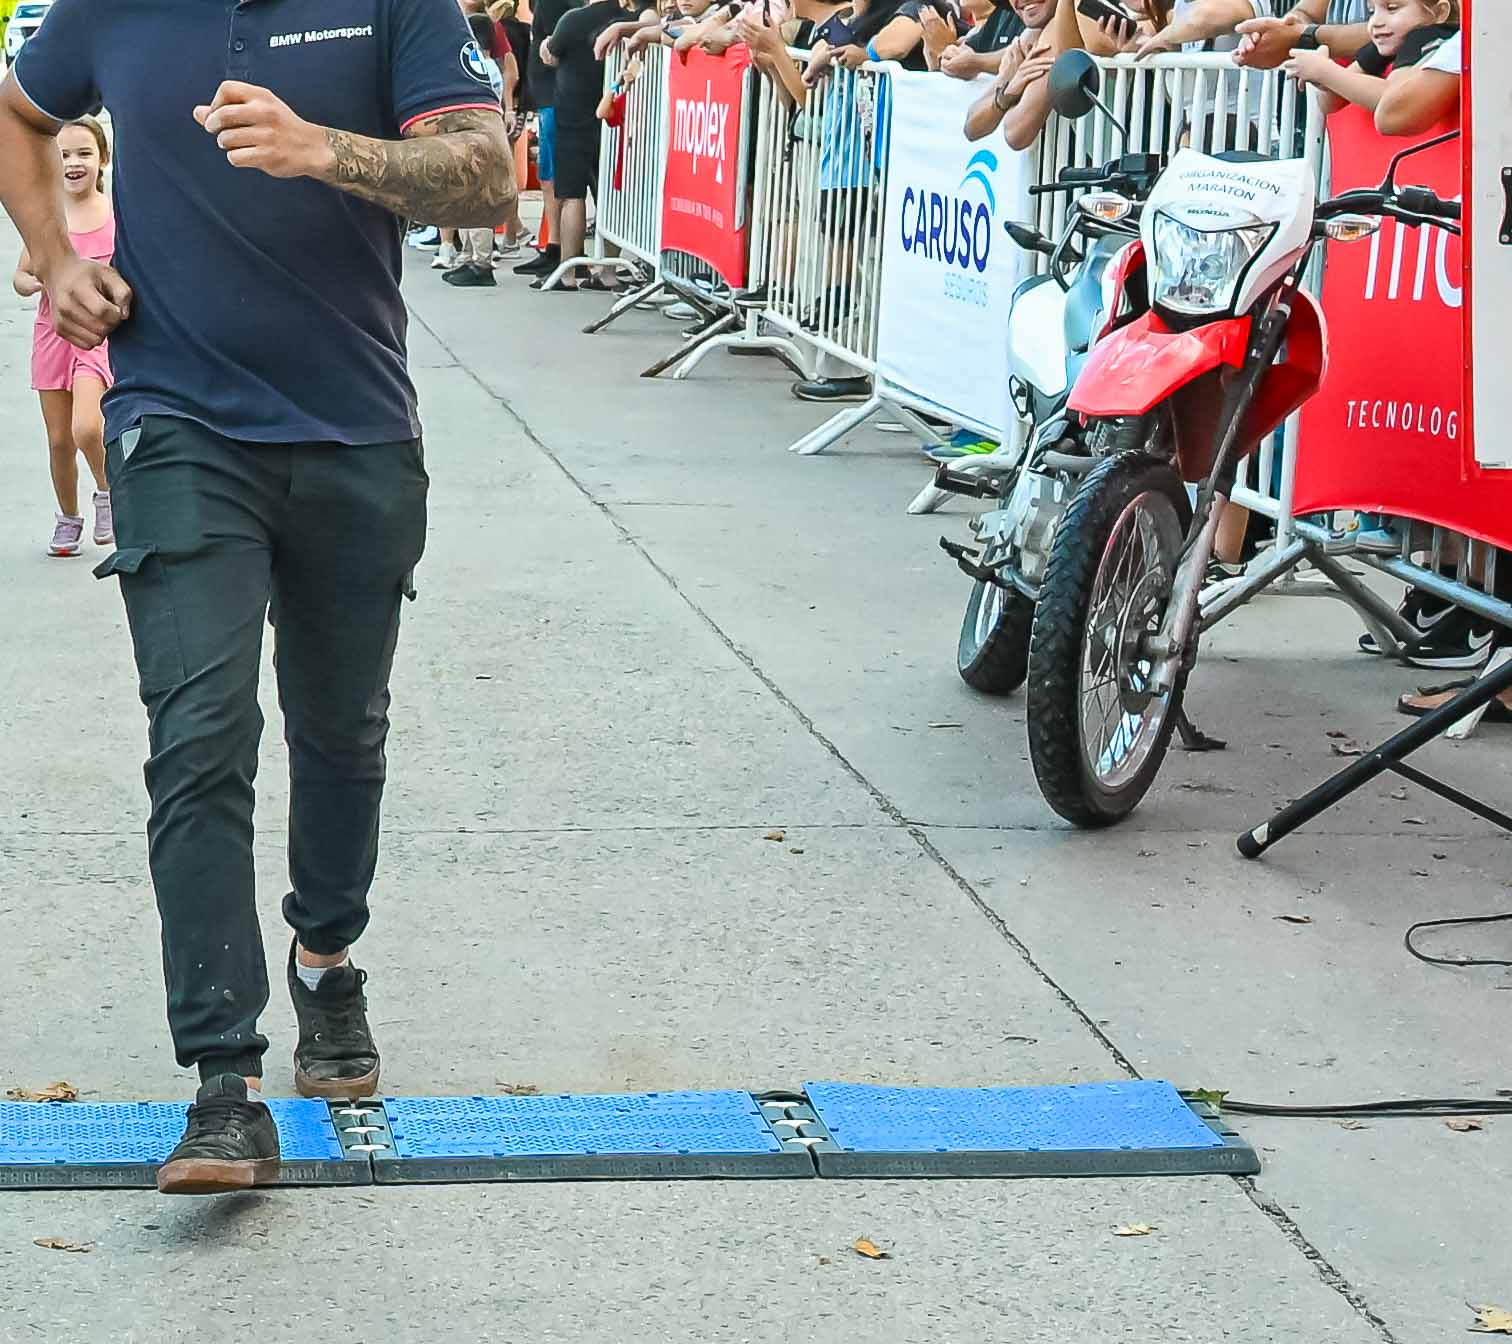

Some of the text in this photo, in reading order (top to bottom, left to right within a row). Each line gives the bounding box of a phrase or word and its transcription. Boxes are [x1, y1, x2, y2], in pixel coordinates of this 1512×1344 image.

[270, 25, 373, 47] BMW Motorsport
[673, 80, 729, 175] moplex
[901, 186, 990, 273] CARUSO
